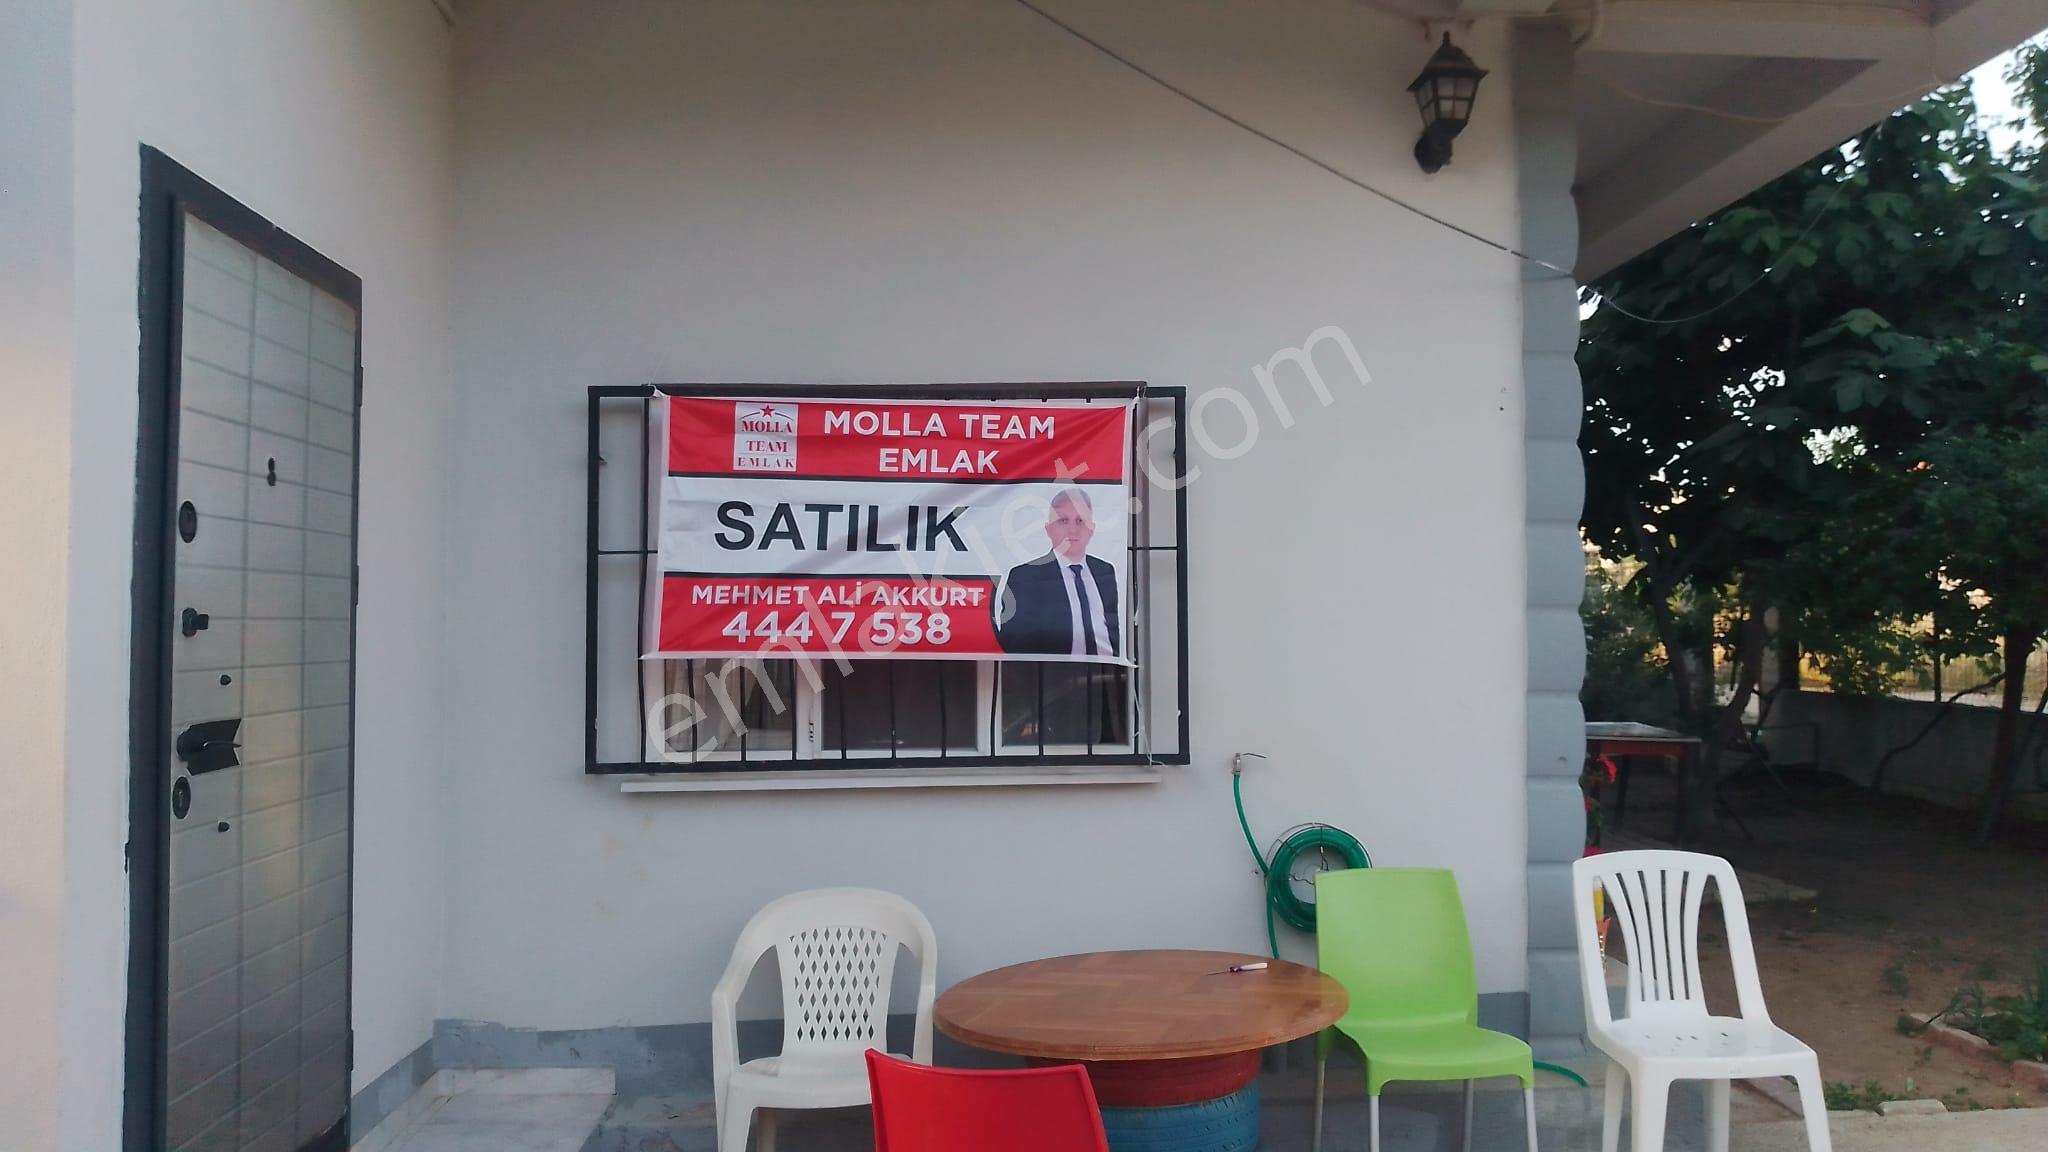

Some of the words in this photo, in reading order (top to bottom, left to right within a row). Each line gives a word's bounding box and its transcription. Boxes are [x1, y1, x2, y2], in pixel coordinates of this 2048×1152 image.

[742, 420, 793, 434] MOLLA
[824, 410, 947, 437] MOLLA
[959, 413, 1055, 440] TEAM
[746, 440, 788, 453] TEAM
[737, 457, 794, 468] EMLAK
[879, 447, 998, 474] EMLAK
[714, 500, 969, 552] SATILIK
[691, 585, 809, 606] MEHMET
[817, 580, 863, 606] ALİ
[871, 586, 985, 607] AKKURT
[722, 611, 811, 644] 444
[831, 612, 853, 643] 7
[870, 612, 951, 644] 538
